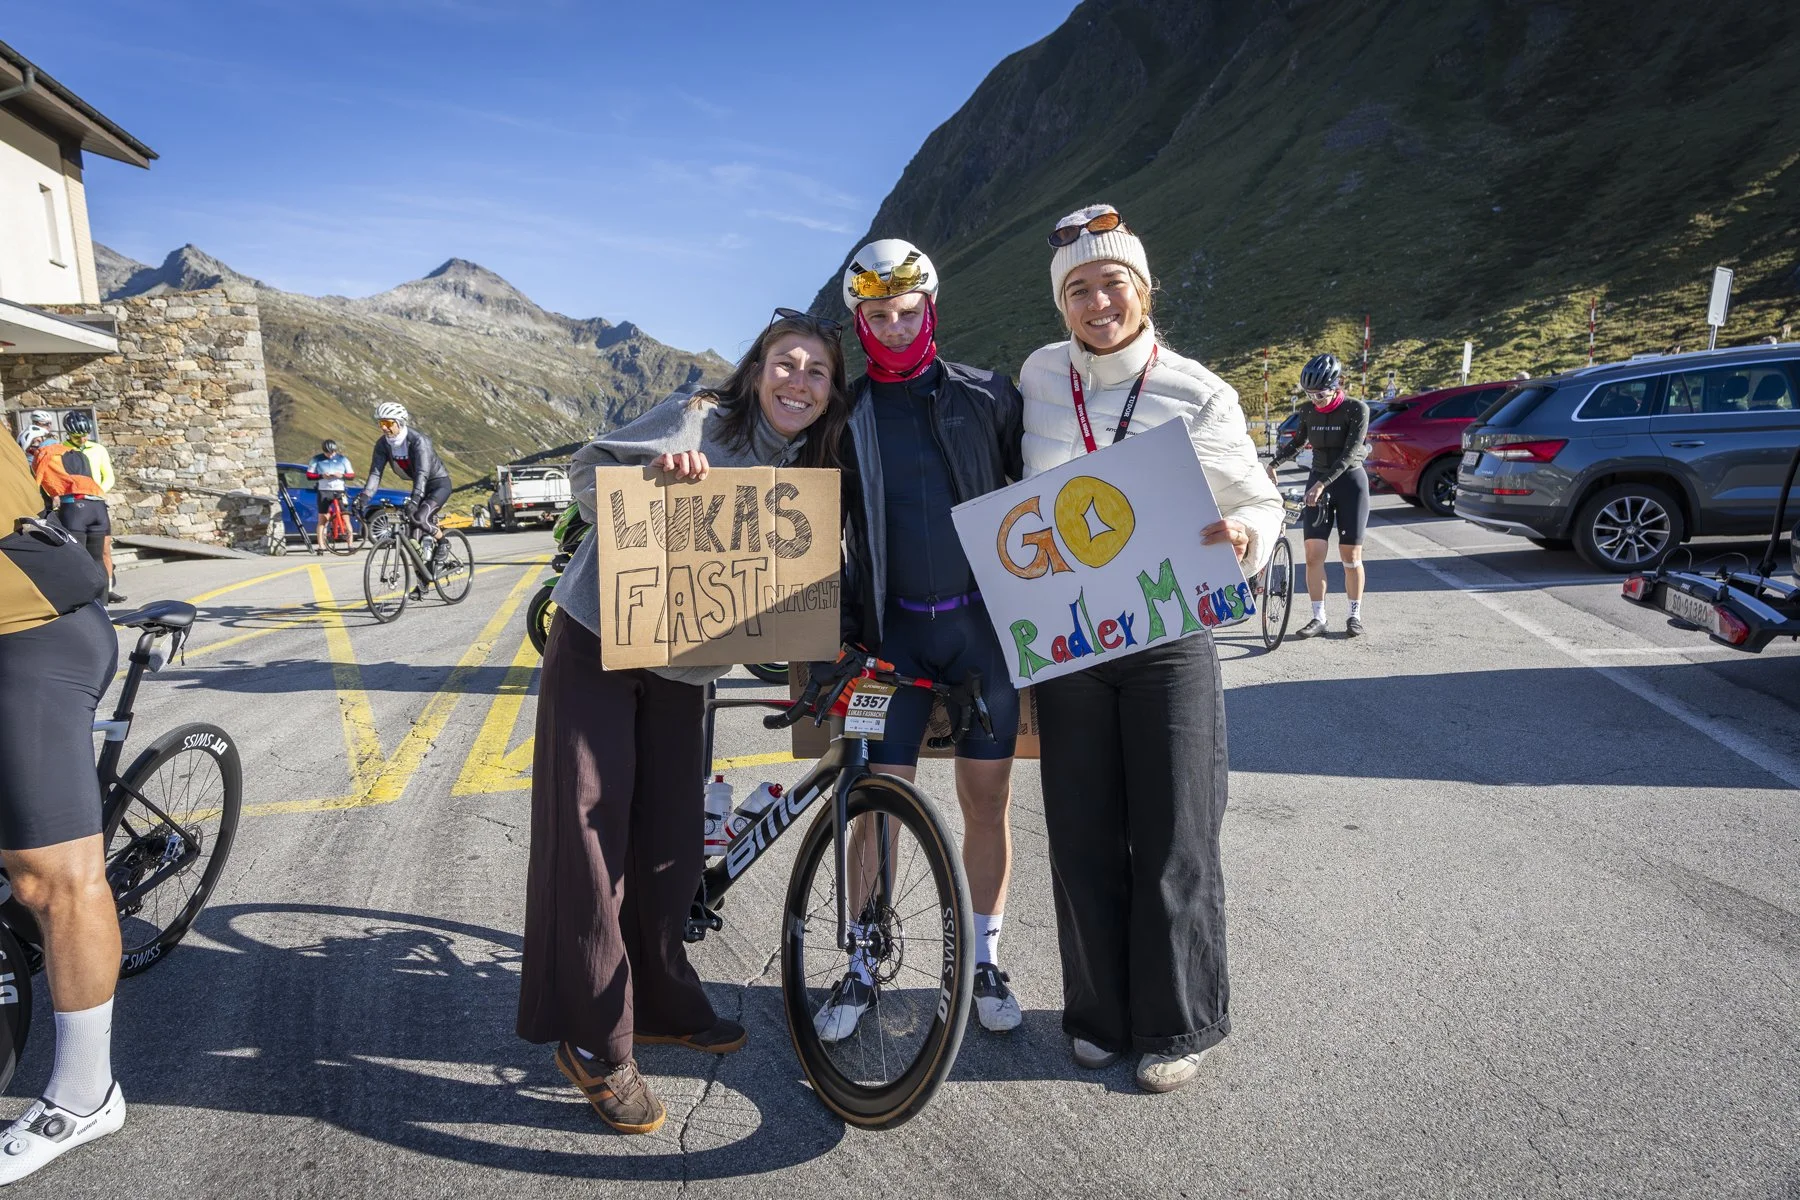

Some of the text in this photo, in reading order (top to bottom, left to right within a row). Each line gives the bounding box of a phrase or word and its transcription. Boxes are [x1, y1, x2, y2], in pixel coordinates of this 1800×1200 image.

[1124, 395, 1136, 417] TUDOR
[610, 482, 813, 559] LUKAS
[997, 475, 1136, 580] GO
[1009, 586, 1139, 681] Radler
[848, 709, 862, 717] LUKAS
[853, 694, 888, 709] 3357
[181, 732, 228, 756] DT SWISS
[127, 942, 161, 970] SWISS
[937, 907, 955, 1024] DT SWISS
